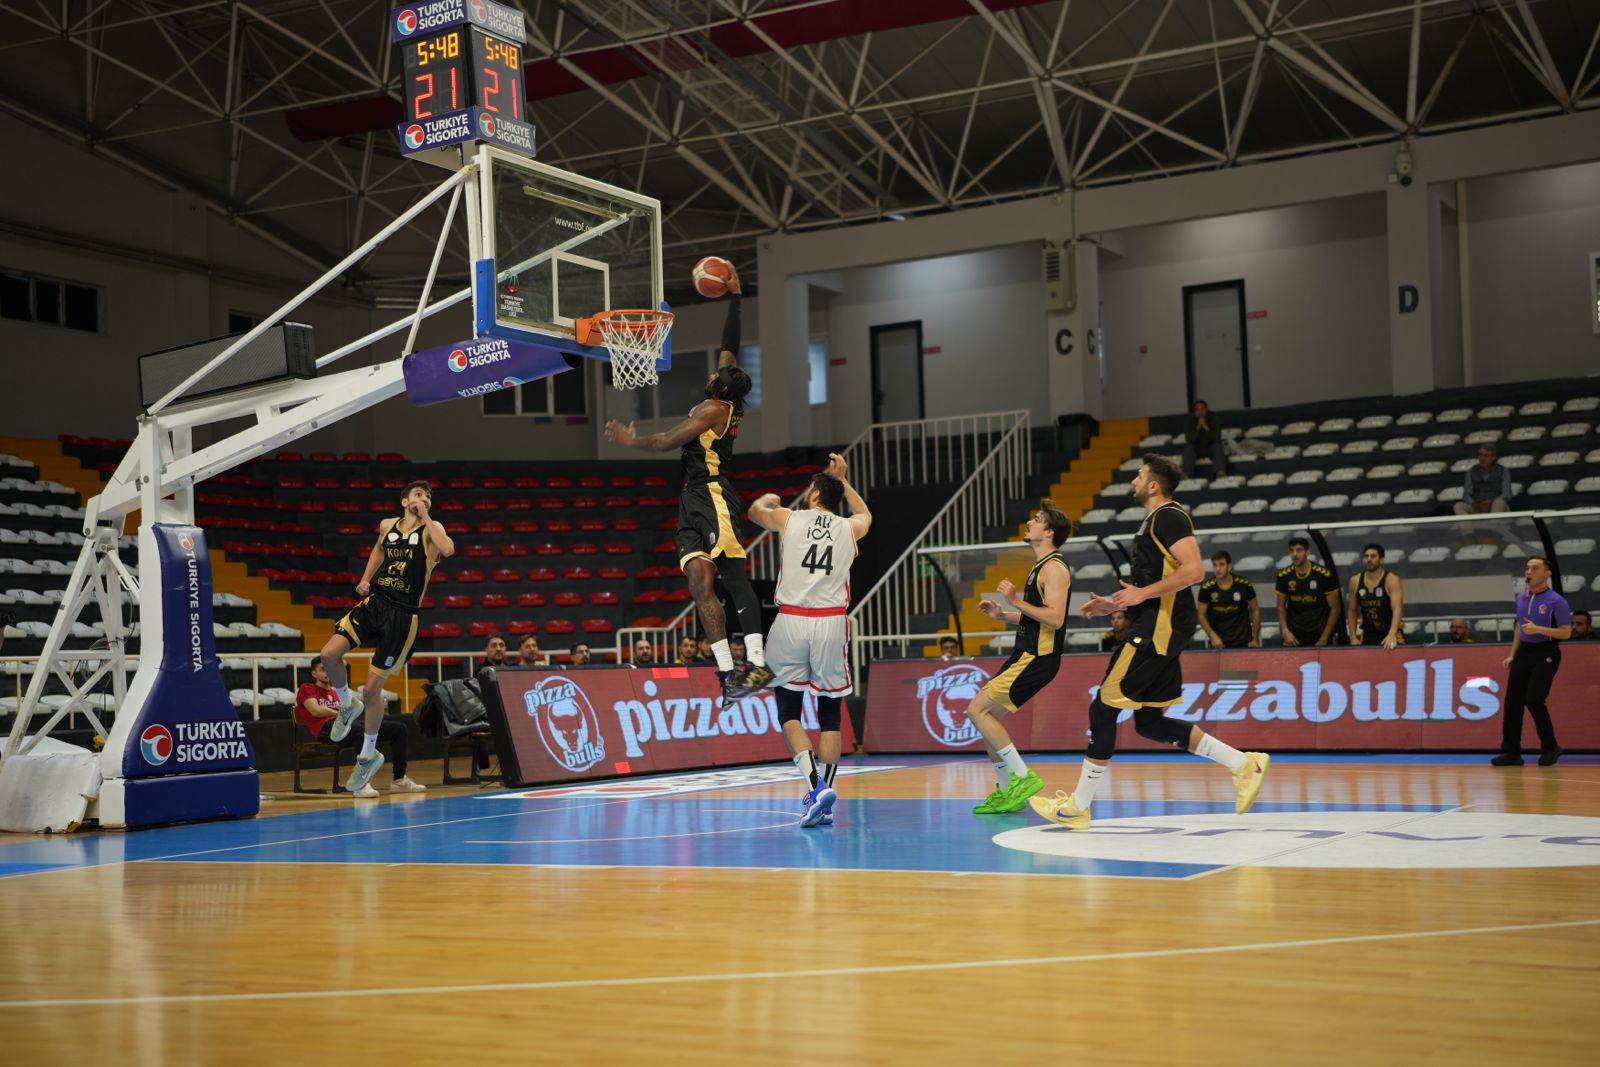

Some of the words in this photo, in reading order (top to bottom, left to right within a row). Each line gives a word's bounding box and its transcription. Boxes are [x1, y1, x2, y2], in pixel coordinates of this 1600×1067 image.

[417, 32, 459, 66] 5:48
[485, 37, 518, 70] 5:48
[415, 67, 457, 119] 21
[483, 68, 518, 120] 21
[1399, 285, 1419, 314] D
[1056, 328, 1073, 355] C
[1087, 328, 1096, 355] C
[388, 561, 407, 577] 24
[801, 543, 834, 576] 44
[524, 680, 576, 716] pizza
[918, 669, 983, 698] pizza
[1086, 658, 1500, 736] zzabulls
[176, 721, 246, 741] TÜRKİYE
[563, 739, 604, 769] bulls
